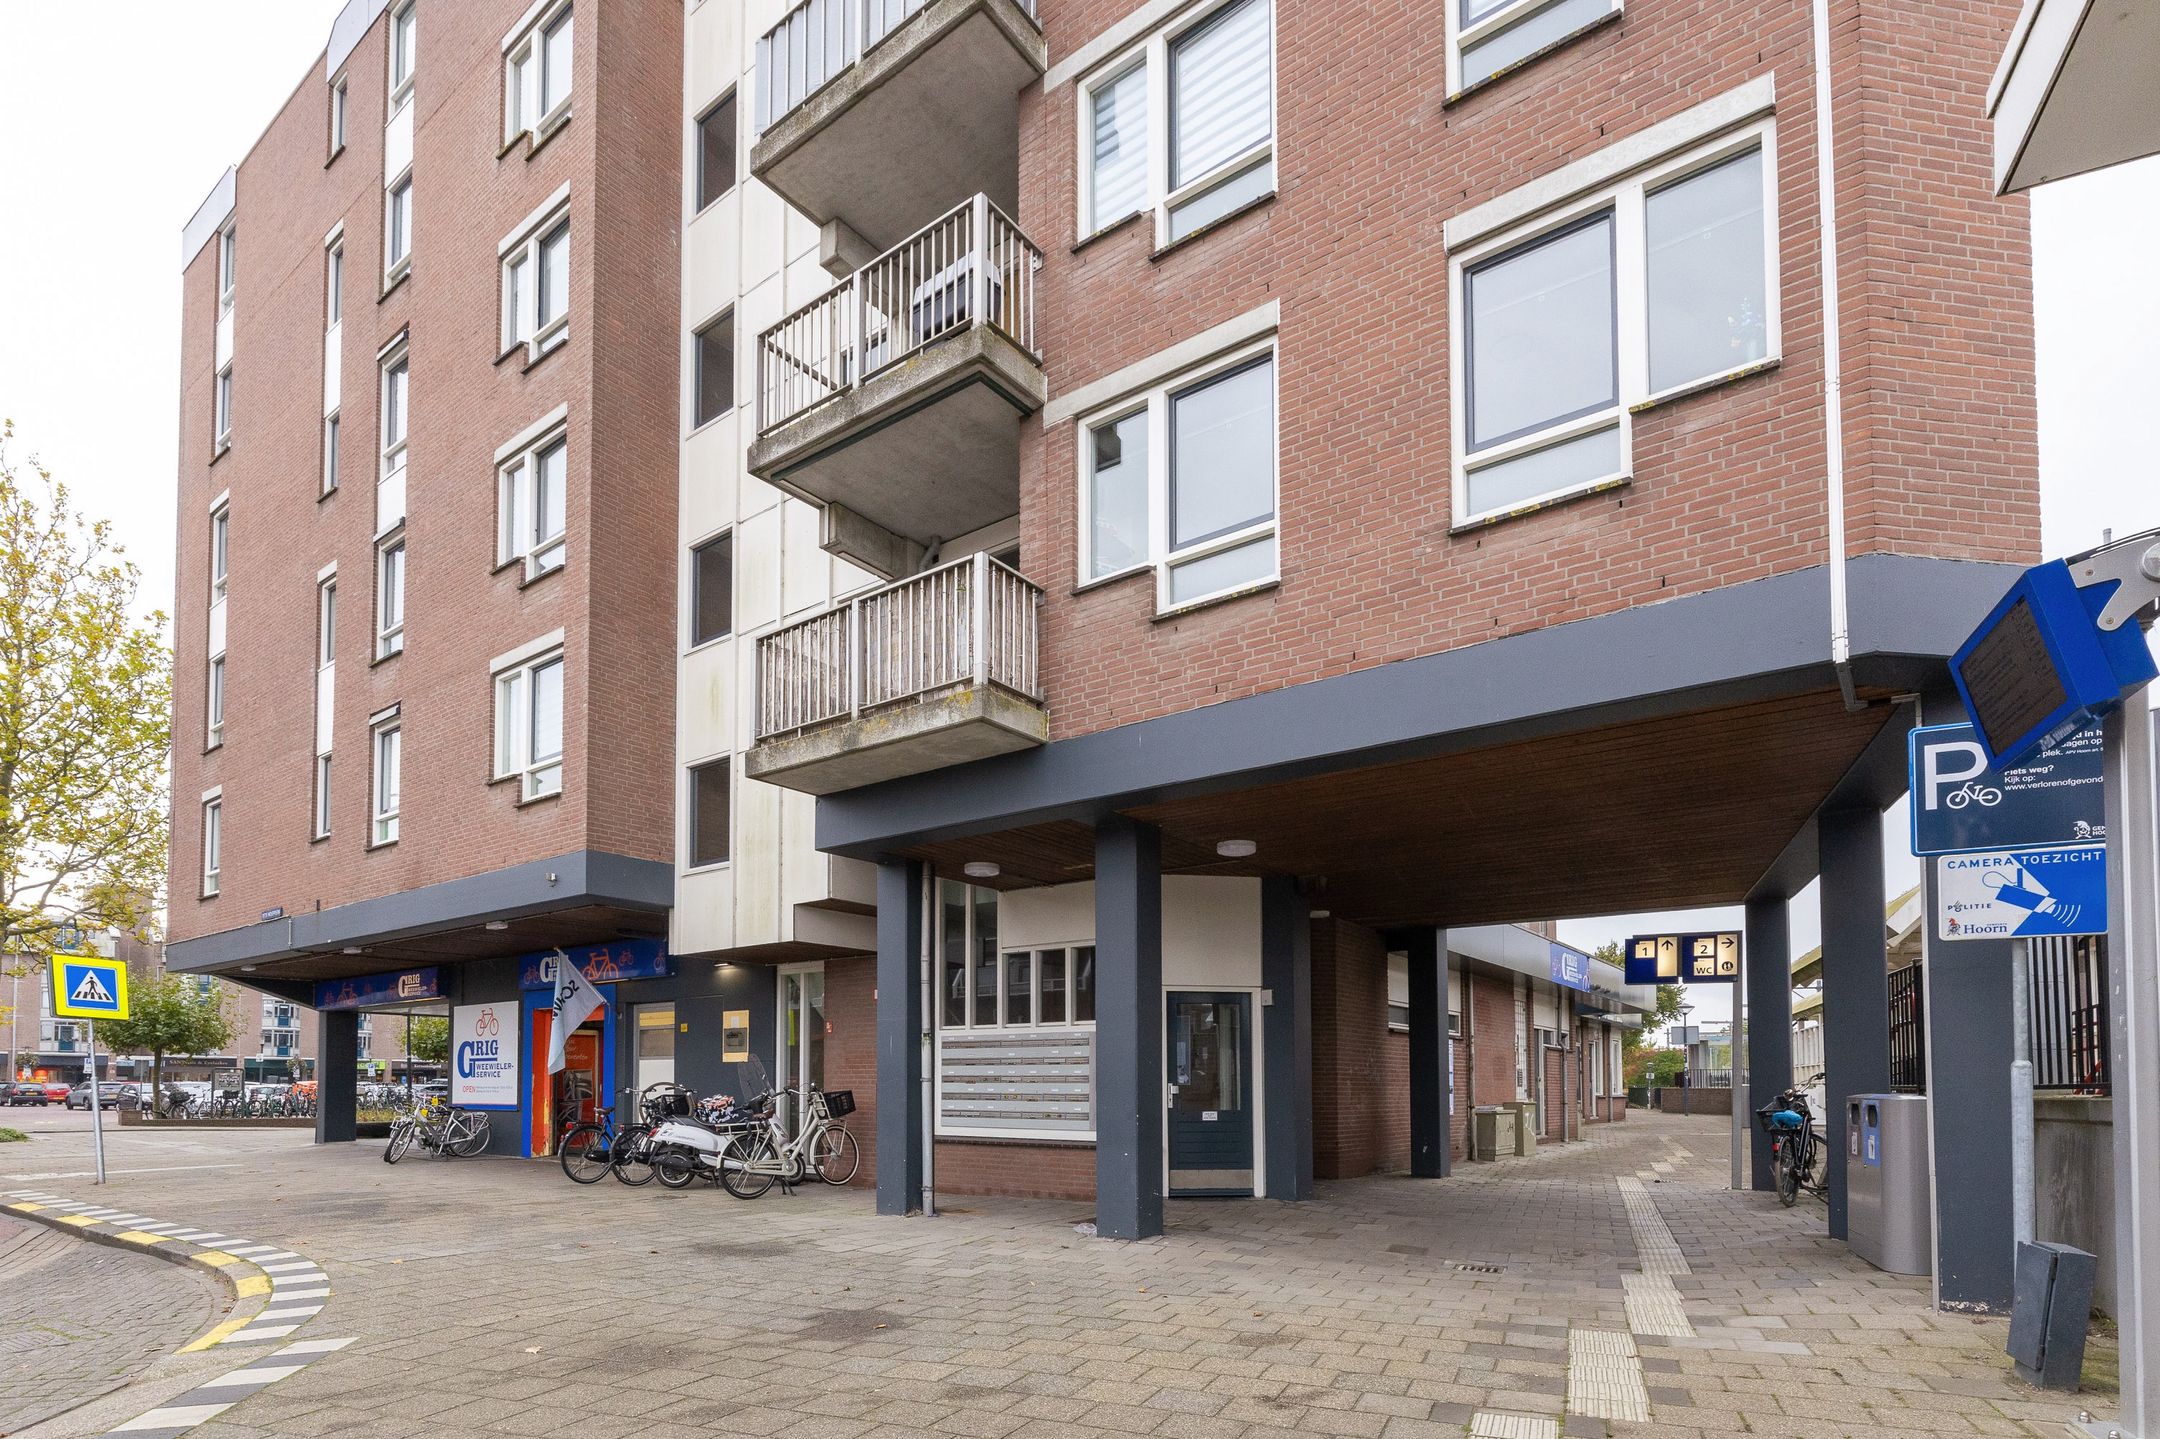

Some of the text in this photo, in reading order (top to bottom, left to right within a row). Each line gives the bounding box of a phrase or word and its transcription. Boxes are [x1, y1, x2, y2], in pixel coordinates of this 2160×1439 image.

[2090, 738, 2103, 746] op
[2042, 749, 2063, 758] plek.
[2029, 765, 2054, 774] weg?
[1924, 741, 1988, 811] P
[2004, 775, 2036, 784] Kijk op:
[1947, 851, 2102, 869] CAMERA TOEZICHT
[1947, 901, 1992, 912] POLITIE
[1963, 924, 2008, 934] Hoorn
[1642, 947, 1648, 956] 1
[1700, 944, 1708, 954] 2
